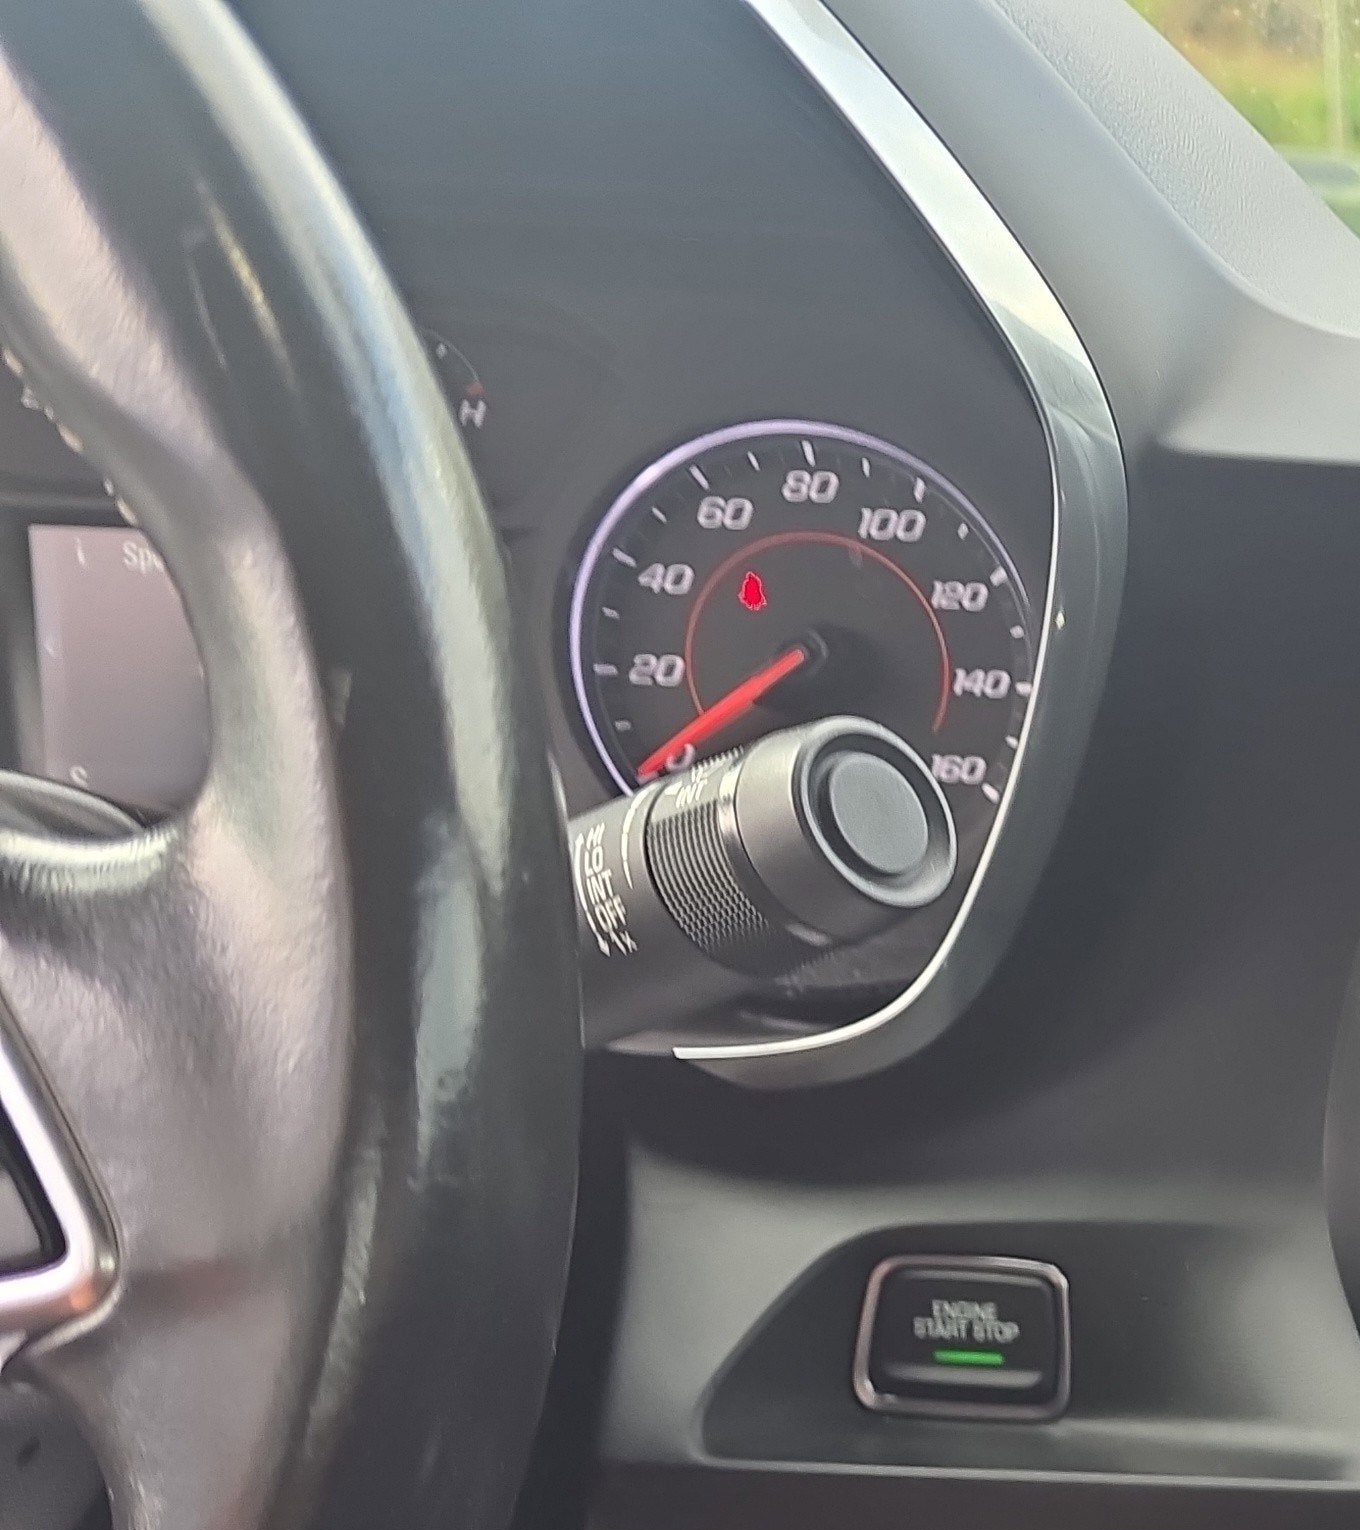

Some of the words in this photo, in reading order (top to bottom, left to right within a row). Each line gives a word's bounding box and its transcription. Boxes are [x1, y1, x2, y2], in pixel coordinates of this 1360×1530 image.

[782, 470, 839, 503] 80
[697, 496, 754, 530] 60
[858, 507, 926, 542] 100
[638, 563, 694, 595] 40
[931, 580, 989, 612] 120
[628, 654, 685, 687] 20
[953, 669, 1011, 699] 140
[931, 755, 986, 785] 160
[584, 845, 604, 878] LO
[586, 868, 613, 905] INT
[594, 894, 628, 934] OFF
